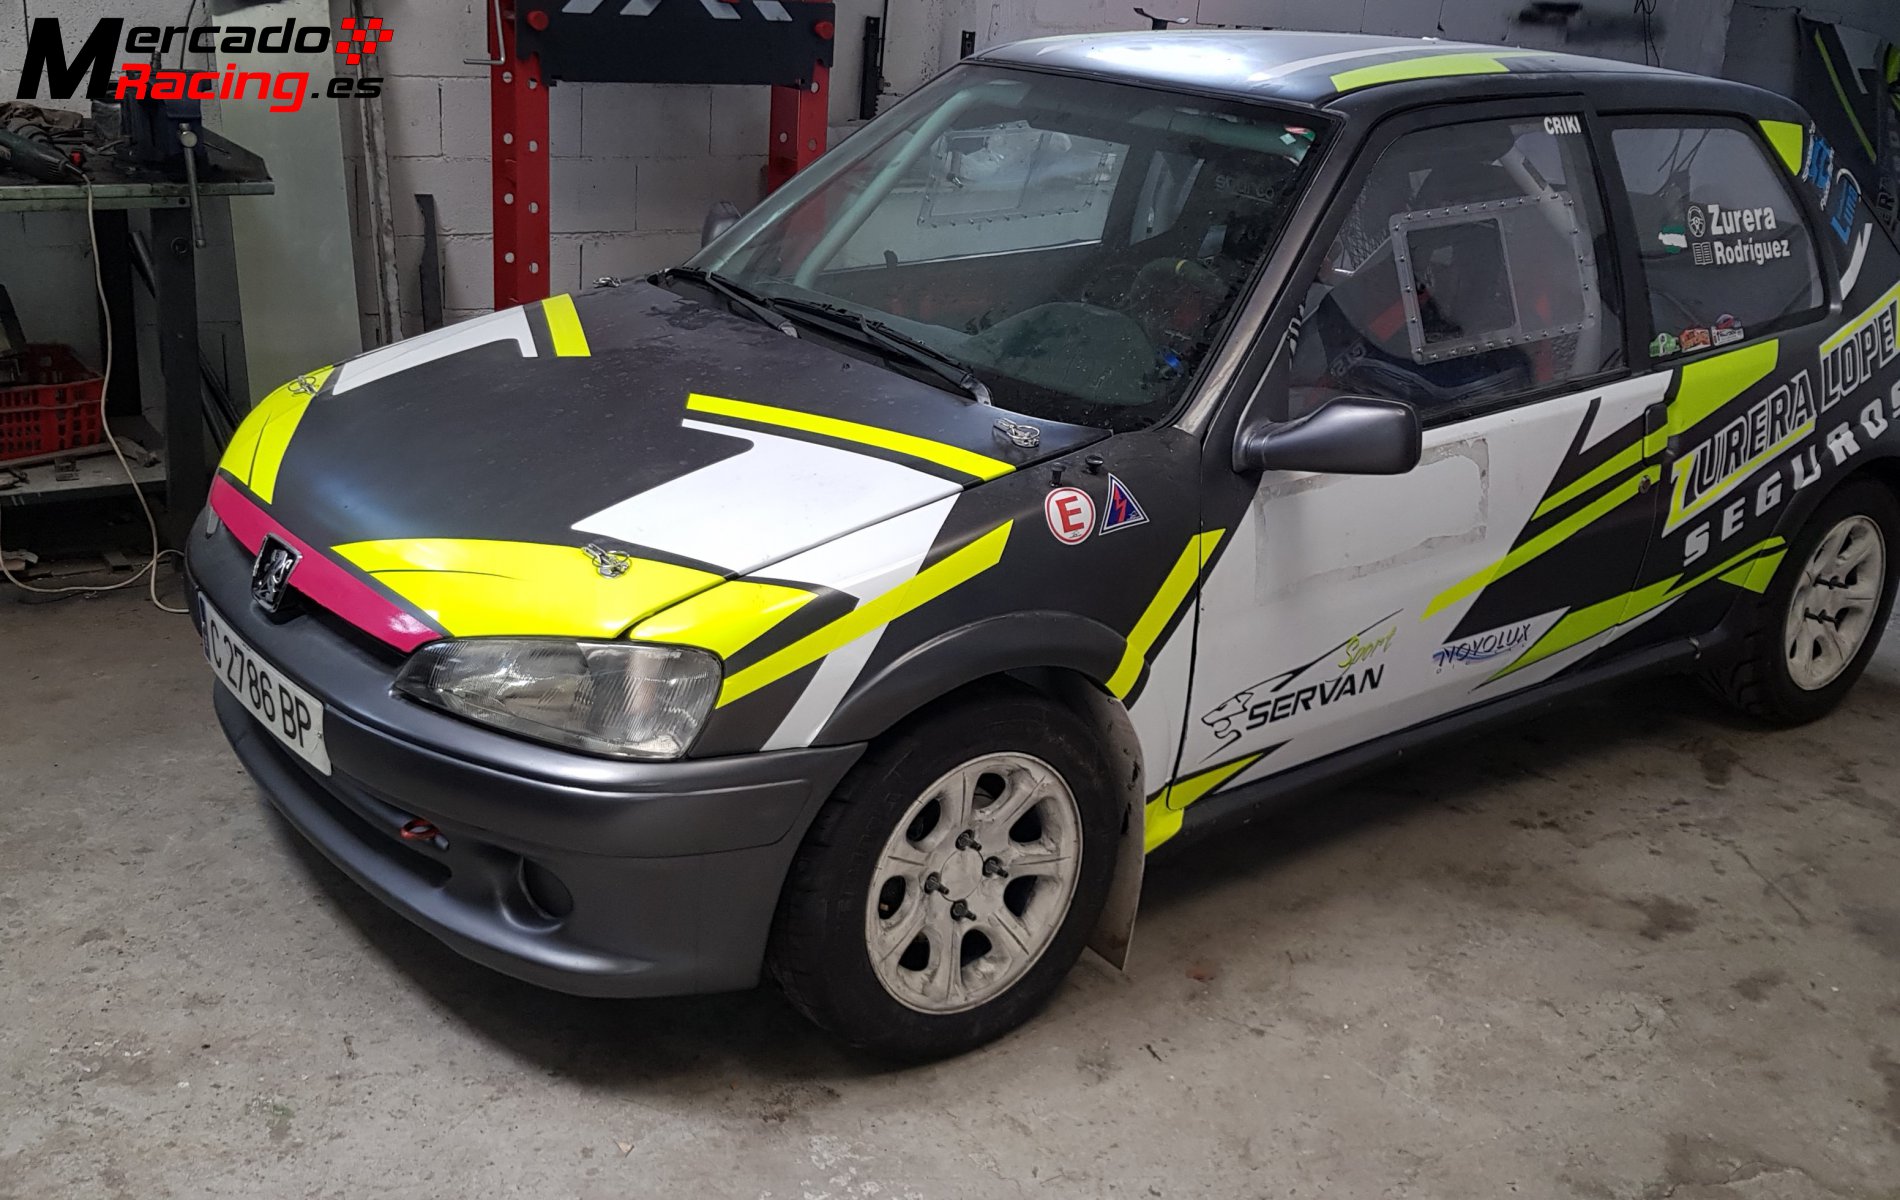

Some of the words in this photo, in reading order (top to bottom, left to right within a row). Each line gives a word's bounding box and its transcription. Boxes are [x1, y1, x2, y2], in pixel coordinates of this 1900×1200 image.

[1543, 115, 1582, 135] CRIKI
[1708, 204, 1776, 235] Zurera
[1713, 237, 1790, 266] Rodríguez
[1661, 369, 1817, 538] ZURERA
[1055, 495, 1084, 533] E
[1338, 626, 1397, 673] Sport
[1433, 624, 1530, 667] NOVOLUX
[211, 619, 222, 669] C
[224, 636, 275, 722] 2786
[279, 683, 311, 748] BP
[1245, 664, 1384, 731] SERVAN
